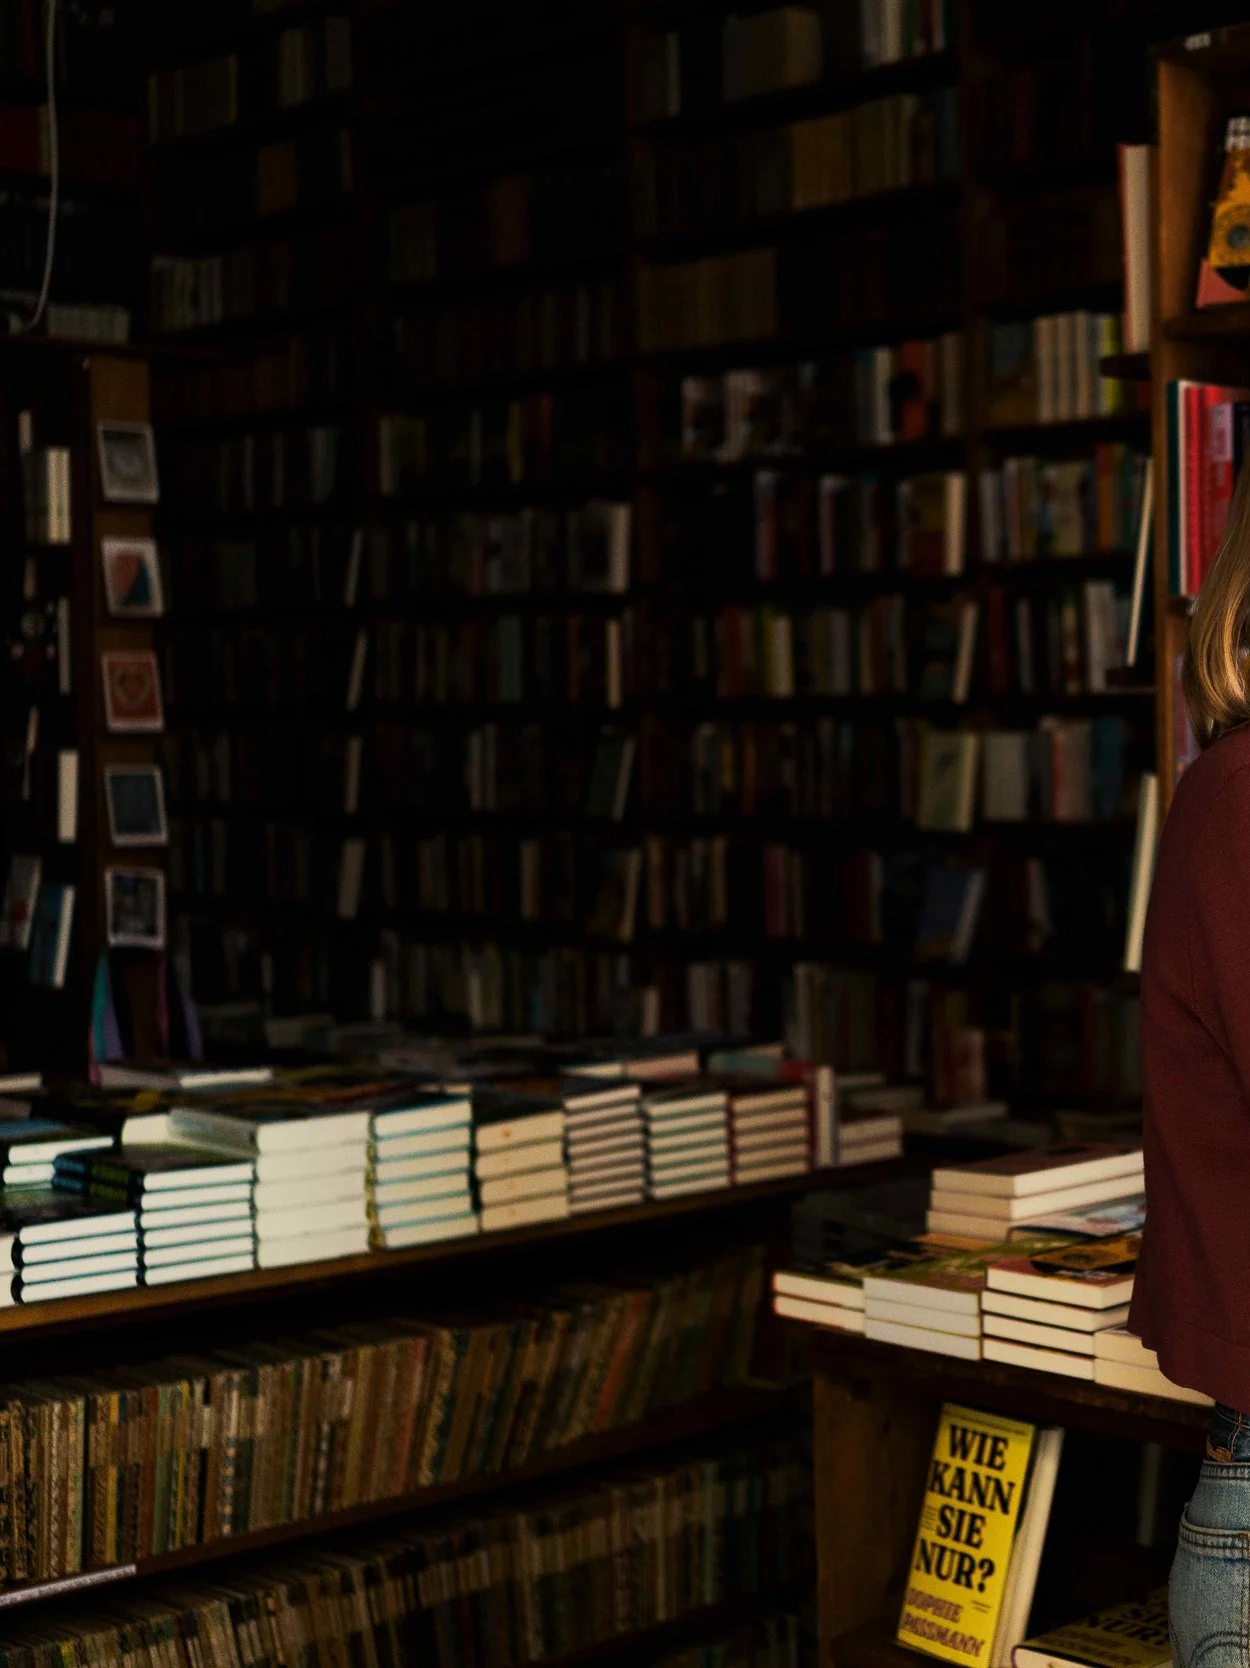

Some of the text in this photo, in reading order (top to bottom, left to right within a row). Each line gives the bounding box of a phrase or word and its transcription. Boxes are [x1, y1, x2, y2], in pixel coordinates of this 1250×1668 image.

[949, 1424, 1009, 1471] WIE
[929, 1460, 1016, 1516] KANN
[936, 1504, 986, 1548] SIE
[915, 1538, 994, 1592] NUR?
